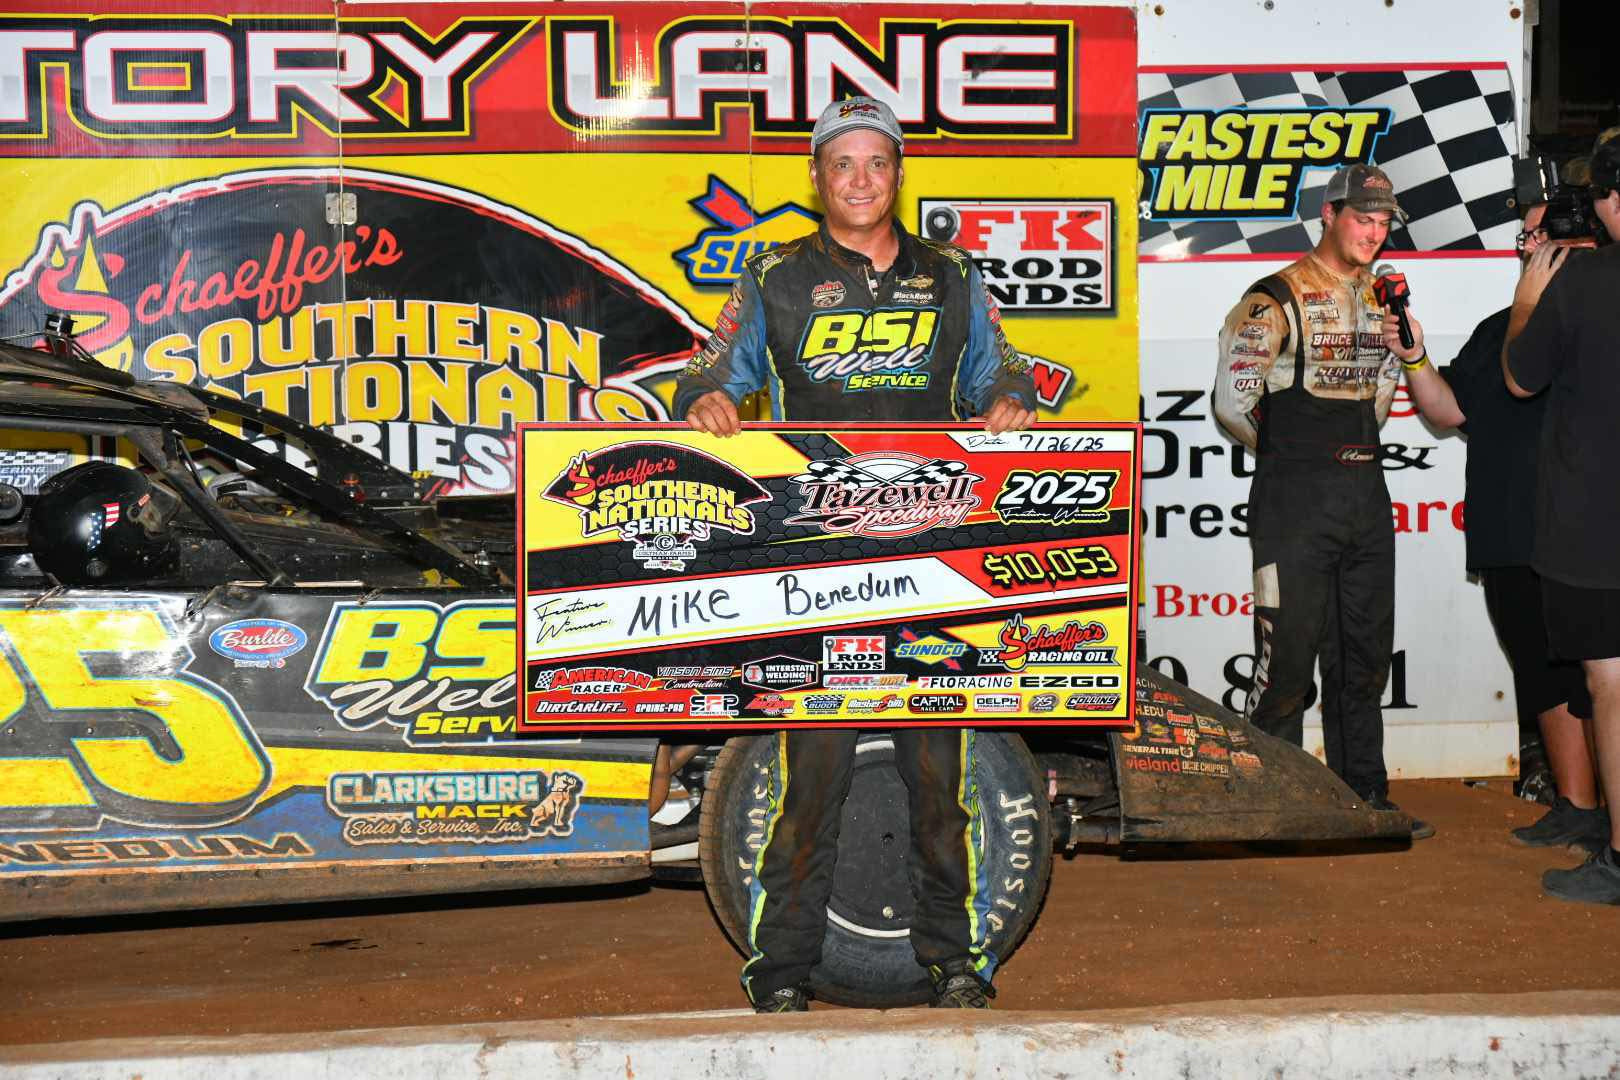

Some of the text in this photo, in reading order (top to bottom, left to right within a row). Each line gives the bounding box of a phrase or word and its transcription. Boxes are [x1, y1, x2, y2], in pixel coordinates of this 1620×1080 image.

[0, 30, 1057, 124] TORY LANE
[1140, 111, 1379, 161] FASTEST
[1155, 164, 1292, 211] MILE
[958, 210, 1103, 250] FK
[972, 257, 1104, 279] ROD
[38, 225, 403, 355] Schaeffer's
[986, 283, 1104, 305] NDS
[144, 298, 604, 386] SOUTHERN
[802, 311, 937, 359] BSI
[1313, 334, 1352, 347] BRUCE
[808, 345, 923, 380] Well
[848, 373, 928, 389] Service
[1019, 434, 1105, 452] 7/26/25
[566, 457, 677, 498] Schaeffer's
[598, 480, 736, 508] SOUTHERN
[800, 477, 976, 512] Tazewell
[999, 475, 1112, 505] 2025
[588, 500, 752, 532] NATIONALS
[820, 500, 972, 534] Speedway
[624, 516, 708, 539] SERIES
[984, 546, 1118, 587] $10,053
[776, 572, 920, 616] Benedum
[832, 638, 884, 653] FK
[897, 643, 964, 656] SUNOCO
[999, 622, 1105, 661] Schaeffer's
[828, 661, 883, 670] ENDS
[837, 653, 883, 662] ROD
[1028, 650, 1109, 662] RACING OIL
[550, 667, 652, 690] AMERICAN
[573, 684, 621, 693] RACER
[664, 679, 723, 691] Construction
[930, 677, 1013, 689] FLORACING
[1020, 675, 1119, 688] EZGO
[911, 696, 964, 707] CAPITAL
[976, 697, 1019, 705] DELPH
[1034, 696, 1053, 707] XS
[1066, 696, 1117, 707] COLLINS
[333, 774, 540, 804] CLARKSBURG
[416, 803, 528, 819] MACK
[350, 818, 396, 837] Sales
[400, 819, 412, 834] &
[487, 817, 523, 834] Inc.
